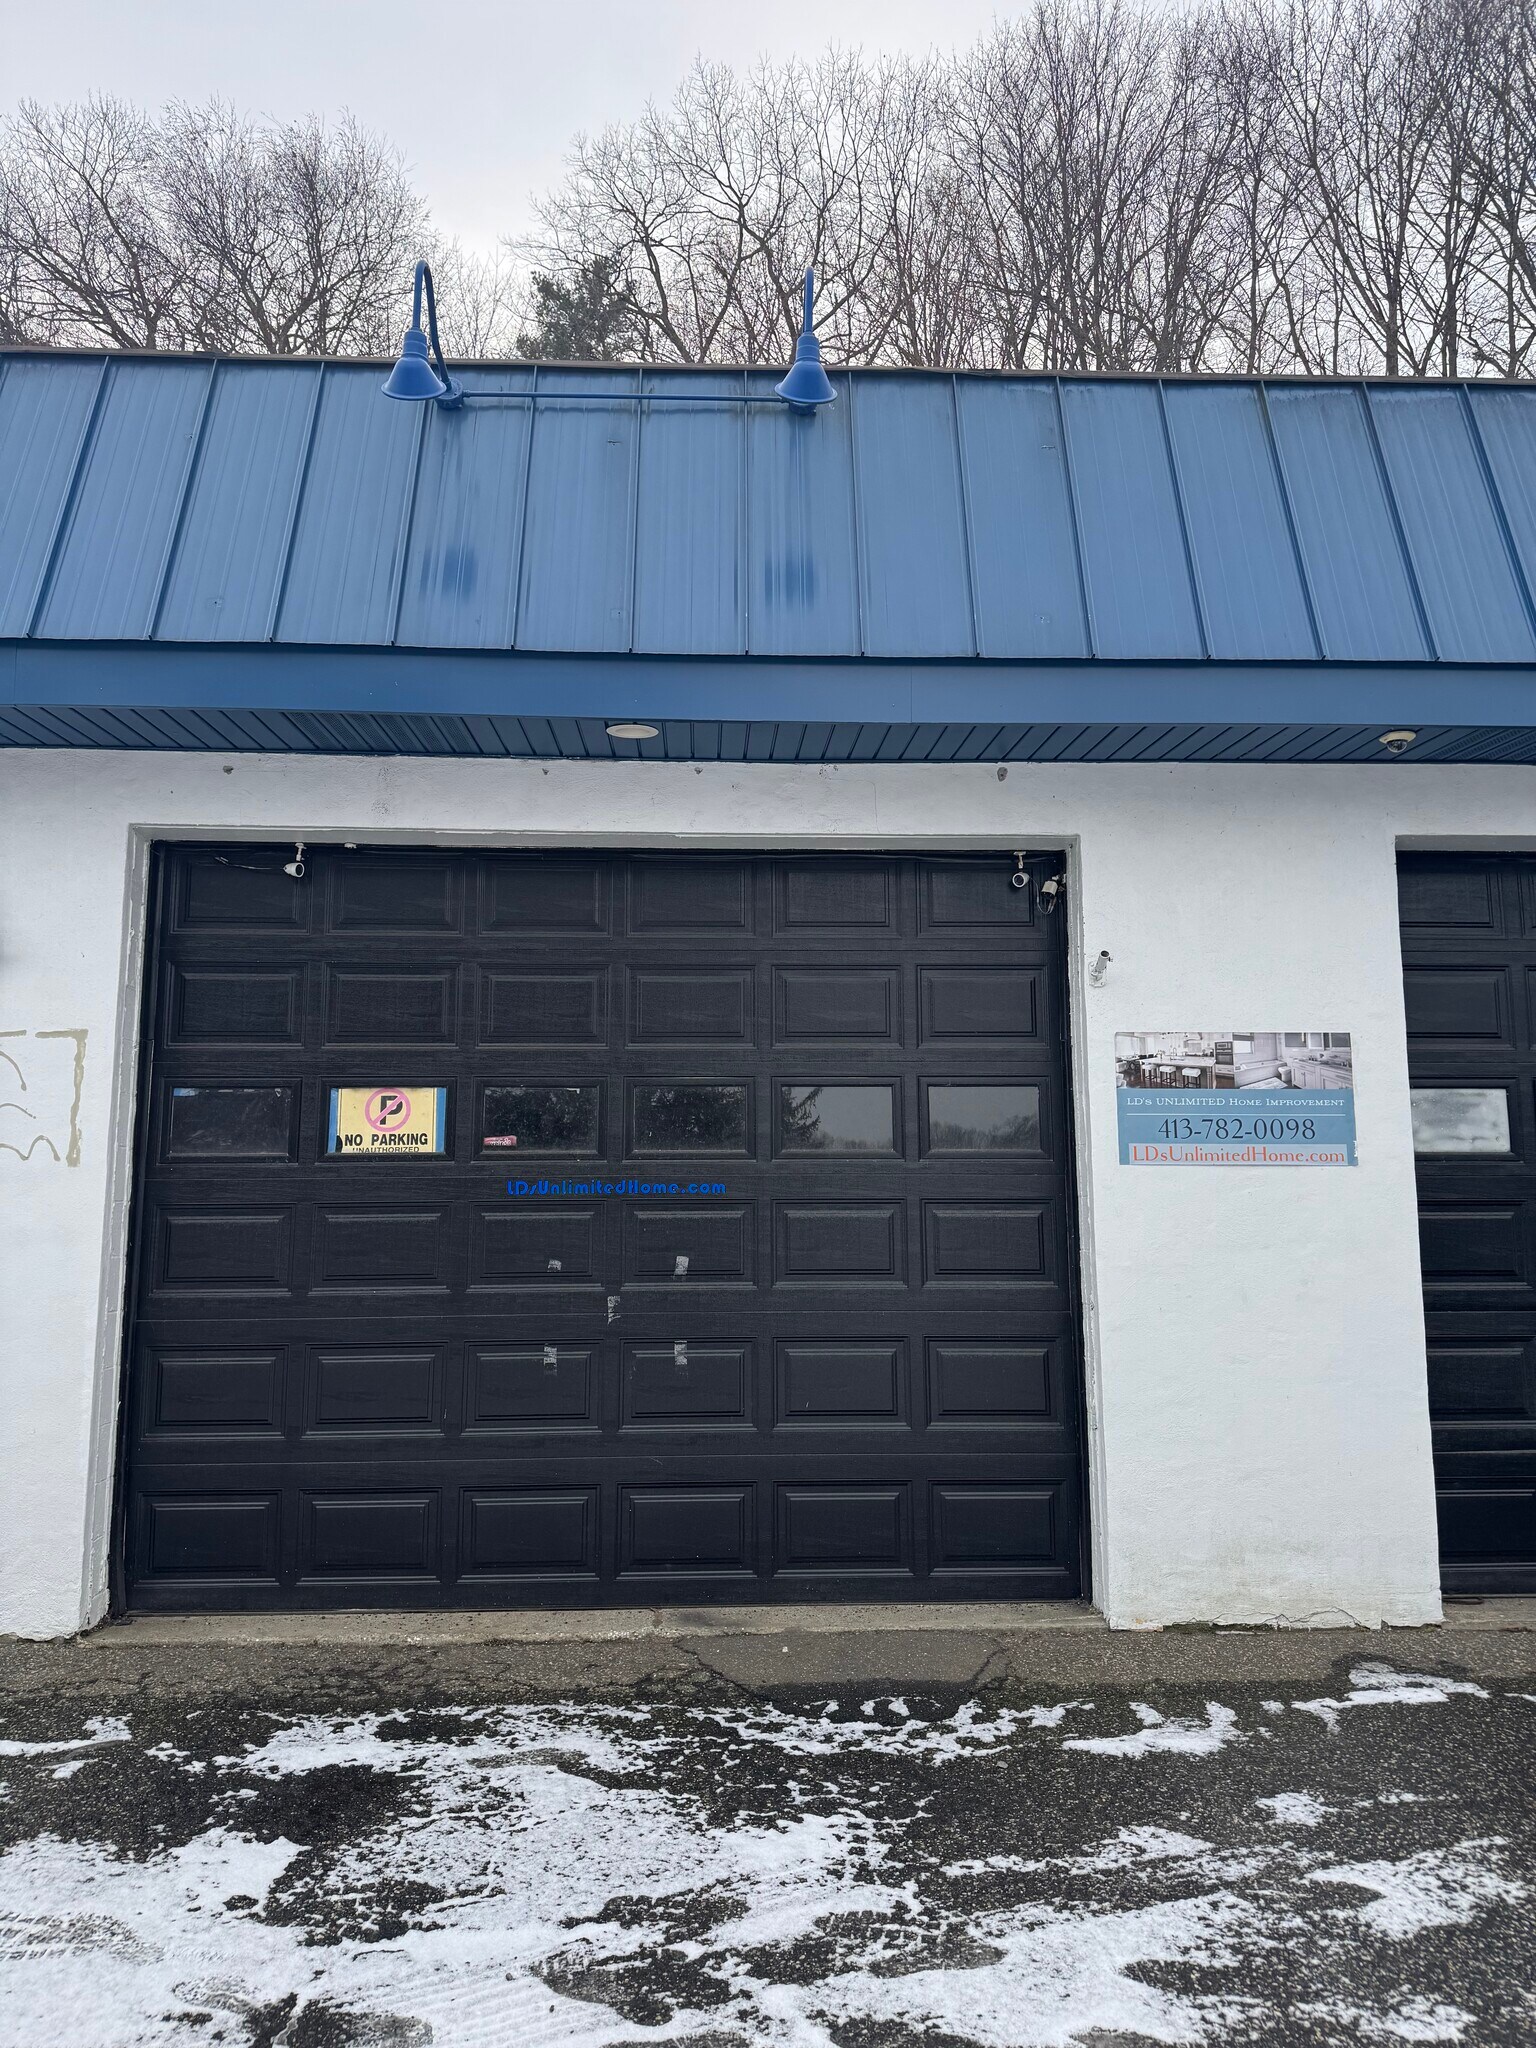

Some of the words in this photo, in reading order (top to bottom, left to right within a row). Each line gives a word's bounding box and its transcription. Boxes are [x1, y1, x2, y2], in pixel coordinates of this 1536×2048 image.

[1156, 1097, 1226, 1106] UNLIMITED
[1158, 1118, 1316, 1140] 413-782-0098
[344, 1133, 363, 1147] NO
[371, 1132, 428, 1146] PARKING
[1132, 1145, 1345, 1162] LDsUnlimitedHome.com
[506, 1179, 727, 1196] LDsUnlimitedHome.com
